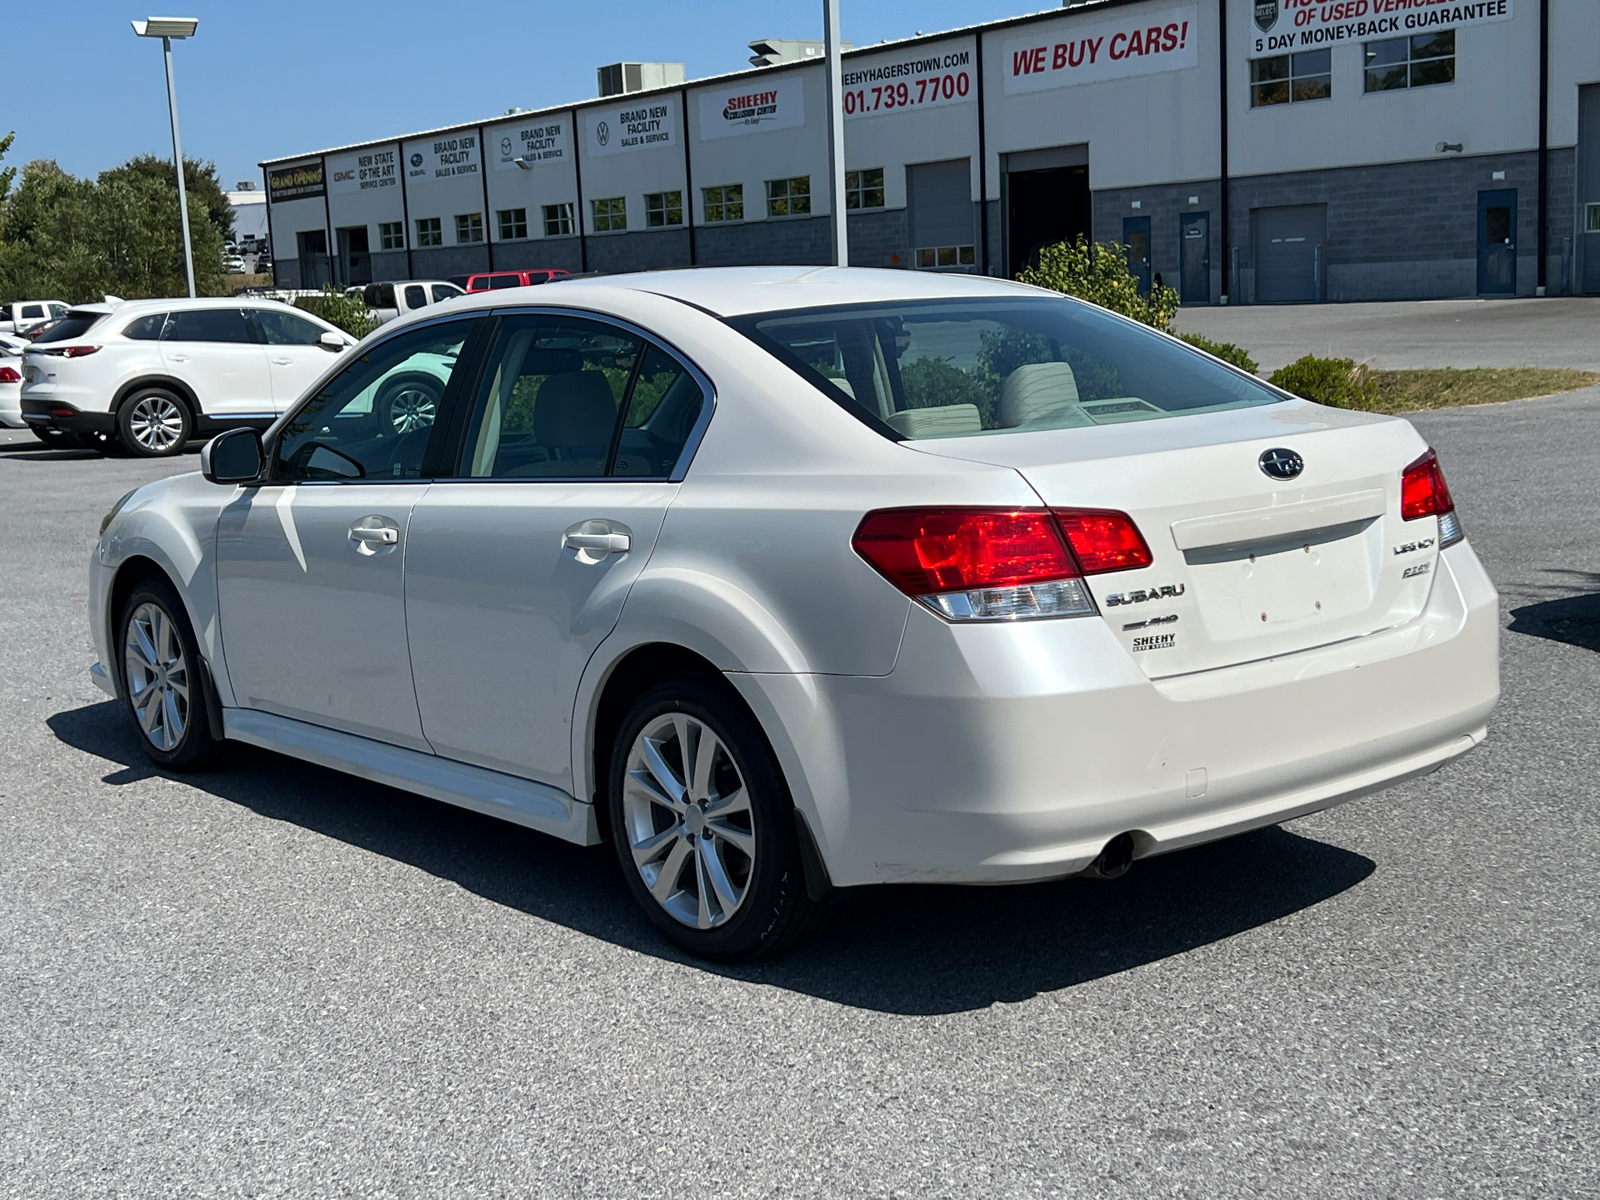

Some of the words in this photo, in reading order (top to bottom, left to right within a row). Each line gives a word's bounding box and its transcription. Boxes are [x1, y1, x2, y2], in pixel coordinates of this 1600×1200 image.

[1293, 8, 1318, 27] OF
[1320, 0, 1369, 23] USED
[1373, 0, 1456, 14] VEHI
[1255, 39, 1264, 52] 5
[1268, 33, 1296, 50] DAY
[1300, 17, 1399, 45] MONEY-BACK
[1404, 0, 1507, 29] GUARANTEE
[1013, 47, 1047, 77] WE
[1052, 36, 1104, 70] BUY
[1109, 21, 1188, 61] CARS!
[728, 90, 778, 111] SHEEHY
[620, 109, 648, 124] BRAND
[649, 106, 668, 119] NEW
[756, 104, 777, 116] CENTER
[520, 128, 544, 142] BRAND
[545, 124, 561, 137] NEW
[627, 119, 661, 135] FACILITY
[434, 139, 458, 154] BRAND
[459, 136, 475, 150] NEW
[526, 137, 556, 152] FACILITY
[621, 136, 639, 147] SALES
[640, 136, 645, 145] &
[645, 132, 670, 144] SERVICE
[358, 155, 373, 168] NEW
[374, 151, 394, 165] STATE
[440, 150, 469, 166] FACILITY
[542, 149, 563, 159] SERVICE
[334, 170, 355, 182] GMC
[359, 168, 368, 180] OF
[368, 166, 381, 179] THE
[381, 164, 395, 178] ART
[435, 167, 451, 178] SALES
[456, 163, 478, 175] SERVICE
[271, 174, 294, 189] GRAND
[360, 180, 378, 190] SERVICE
[378, 177, 396, 188] CENTER
[1393, 537, 1435, 555] LEGACY
[1105, 583, 1185, 607] SUBARU
[1132, 633, 1175, 646] SHEEHY
